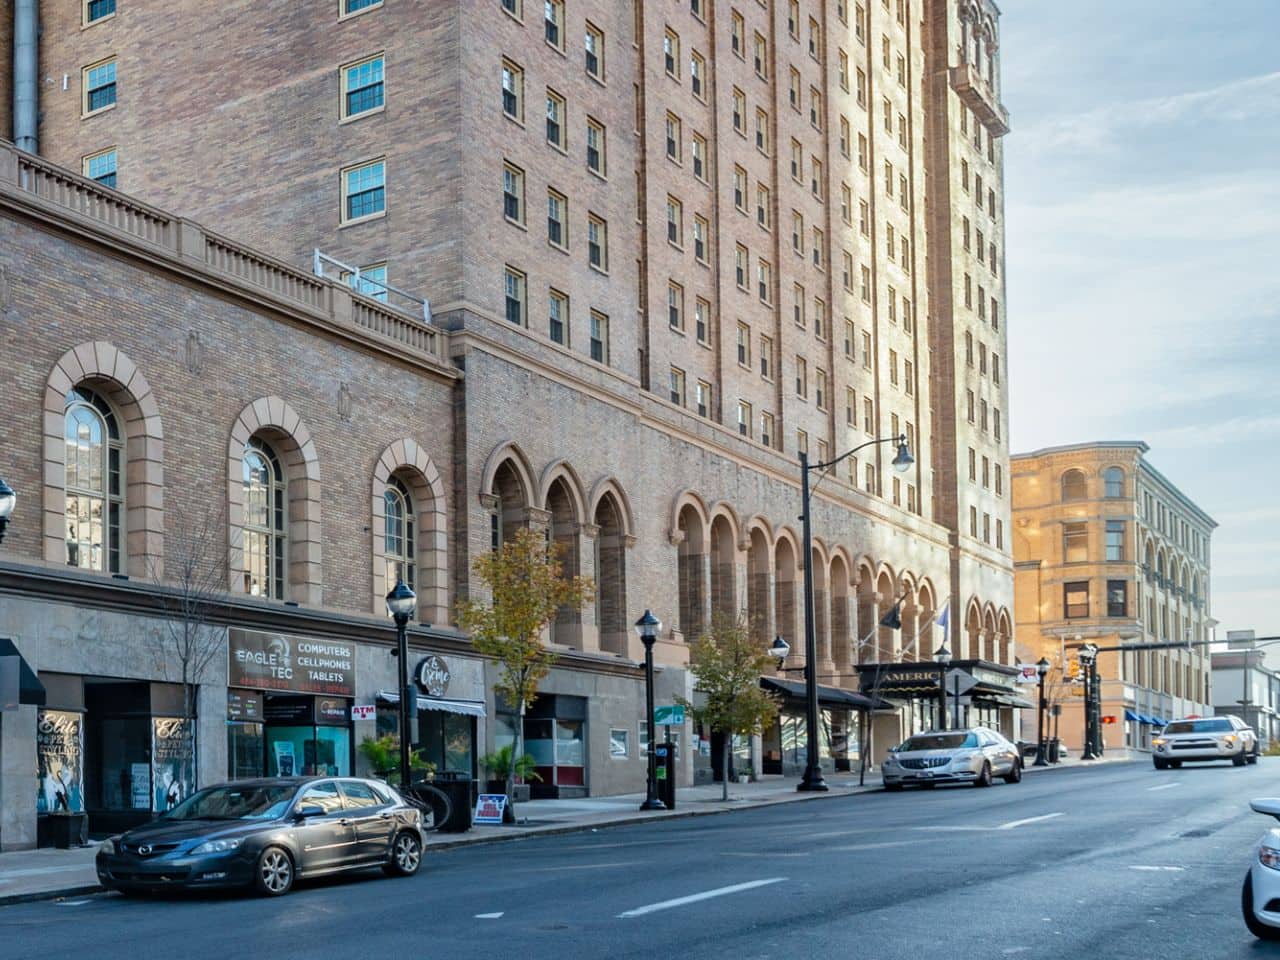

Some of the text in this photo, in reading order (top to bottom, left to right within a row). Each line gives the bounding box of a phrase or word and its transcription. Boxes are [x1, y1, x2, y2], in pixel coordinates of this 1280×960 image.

[297, 643, 351, 657] COMPUTERS
[235, 649, 277, 666] EAGLE
[297, 656, 351, 670] CELLPHONES
[269, 666, 293, 679] TEC
[308, 670, 344, 682] TABLETS
[883, 671, 940, 681] AMERIC
[39, 714, 78, 733] Elite
